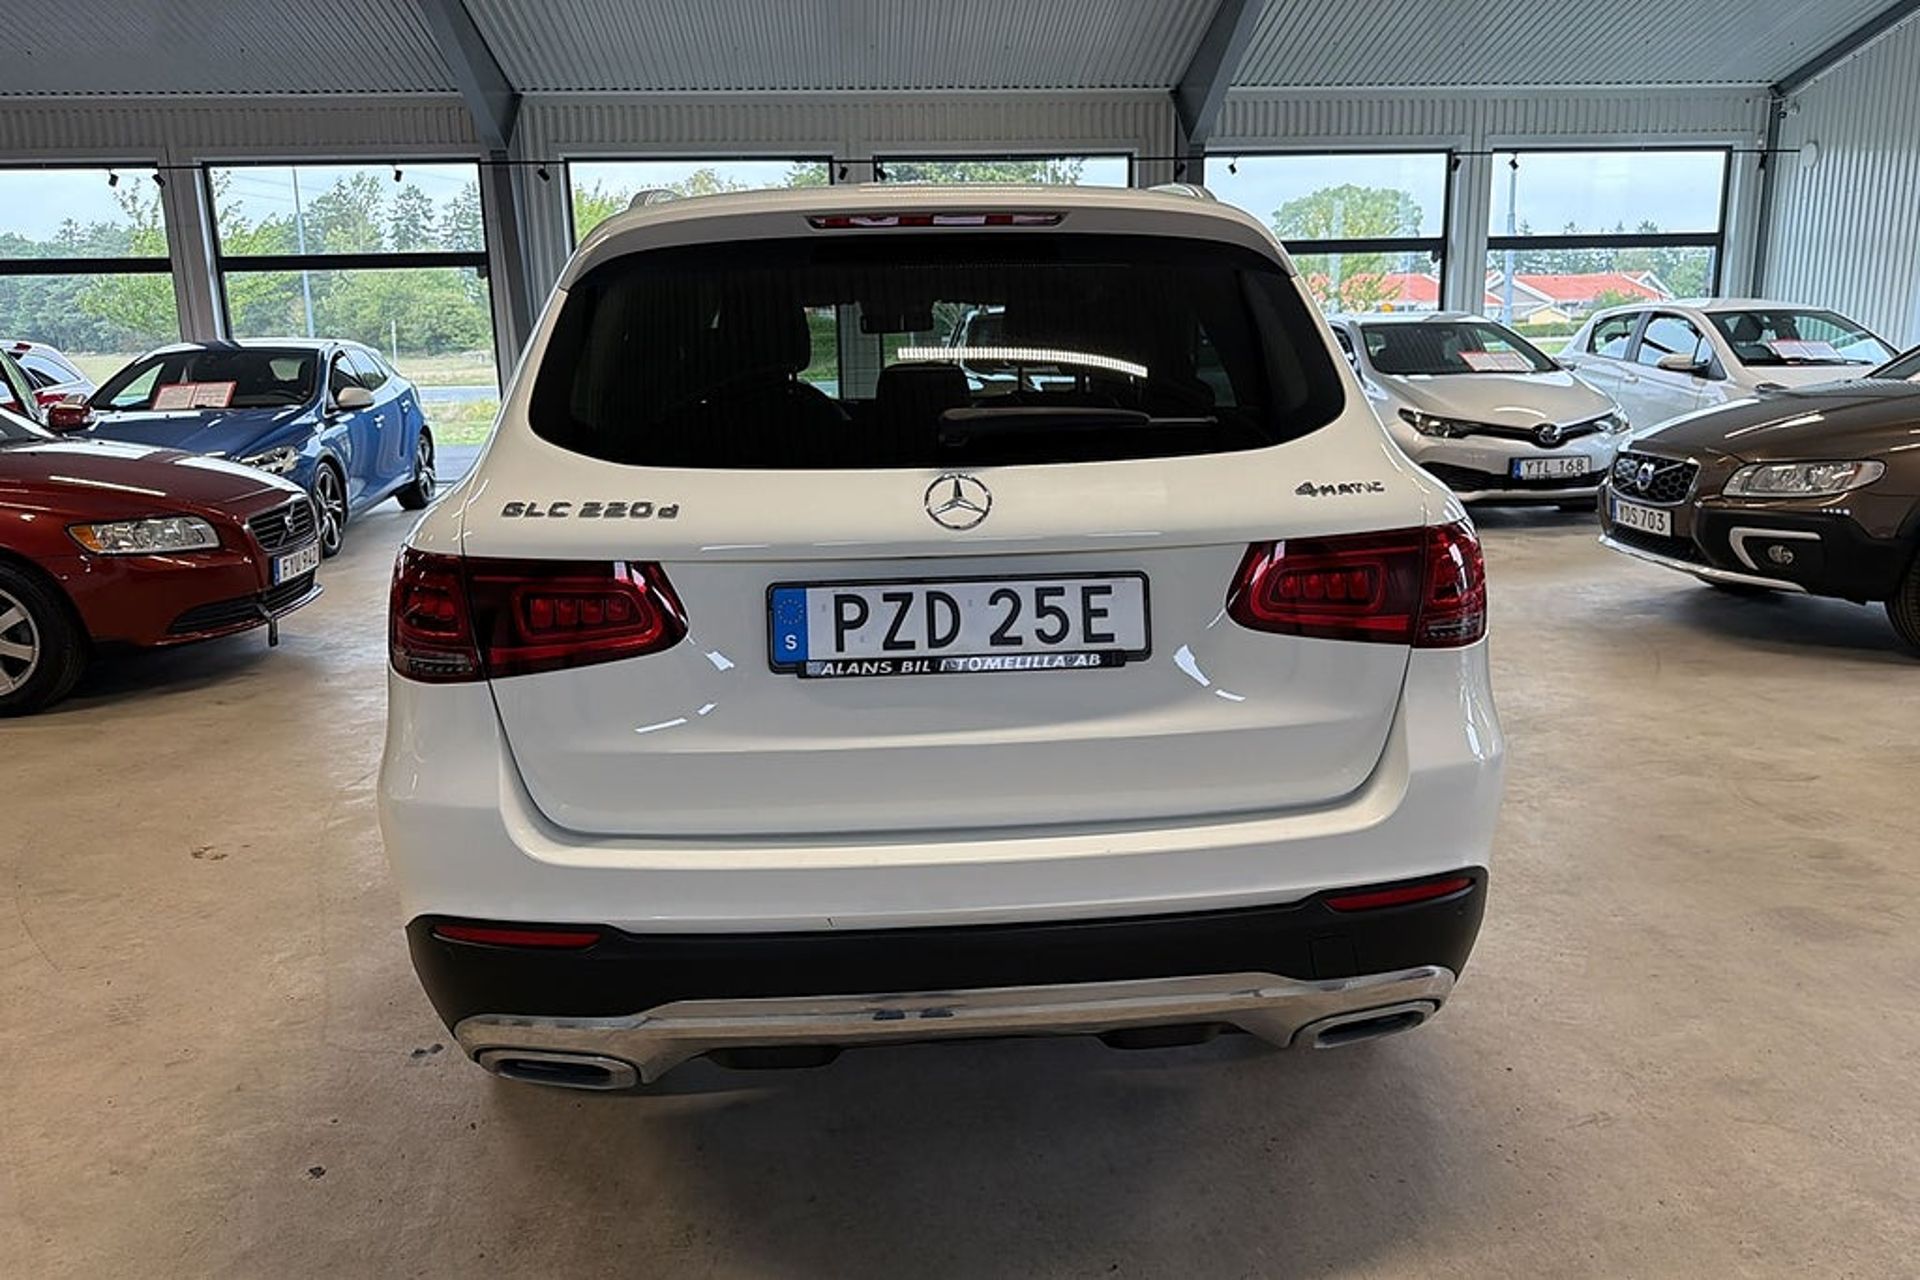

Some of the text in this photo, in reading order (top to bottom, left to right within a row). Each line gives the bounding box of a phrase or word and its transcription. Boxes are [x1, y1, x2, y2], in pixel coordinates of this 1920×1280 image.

[1525, 458, 1585, 474] YTL 168
[1295, 481, 1385, 497] 4MATIC
[502, 502, 572, 518] GLC
[578, 502, 654, 518] 220
[1639, 509, 1666, 531] 703
[784, 585, 1115, 653] S PZD 25E
[821, 660, 893, 676] ALANS
[901, 659, 931, 674] BIL
[957, 655, 1066, 673] TOMELILLA
[1072, 653, 1102, 668] AB
